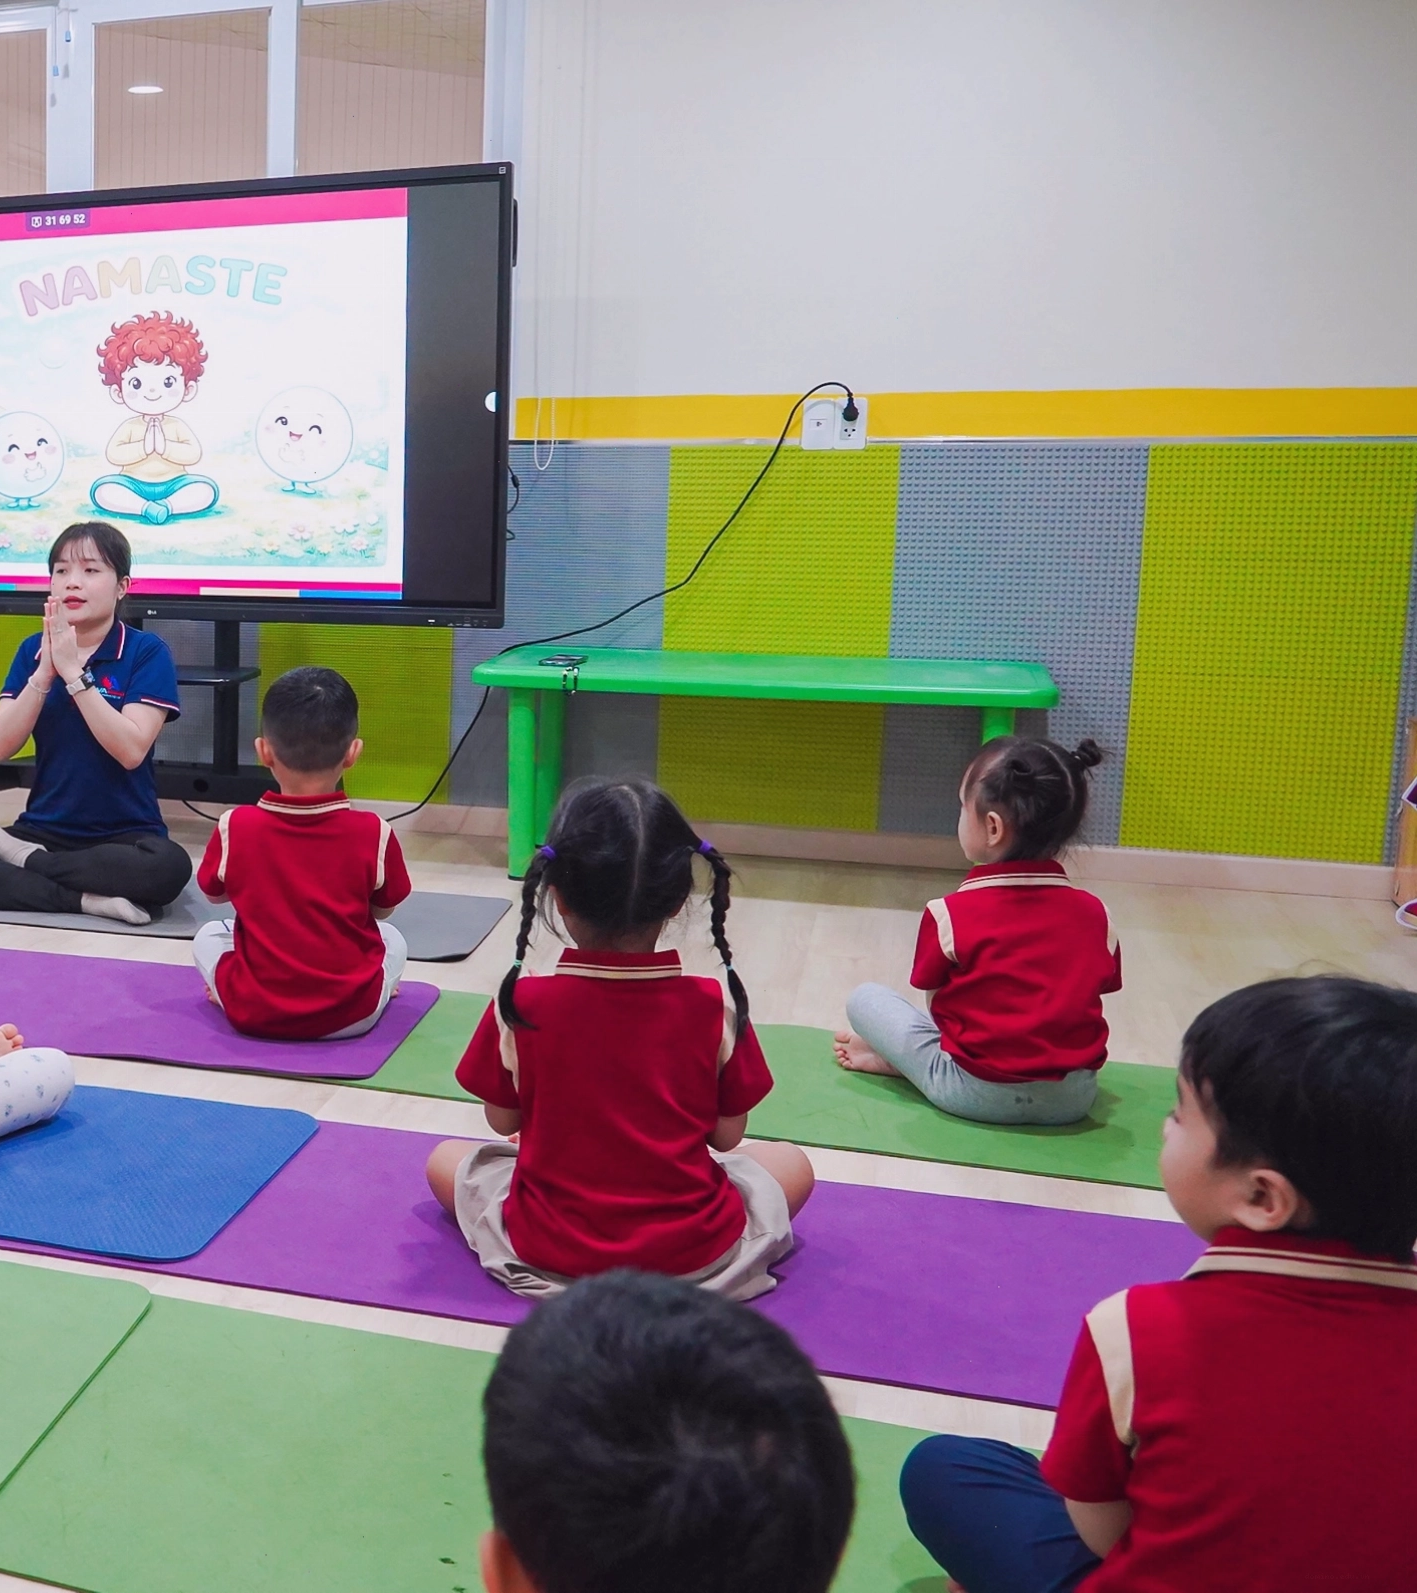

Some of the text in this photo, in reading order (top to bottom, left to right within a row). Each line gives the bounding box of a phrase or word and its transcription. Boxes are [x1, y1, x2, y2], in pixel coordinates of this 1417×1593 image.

[45, 213, 86, 226] 31 69 52
[19, 255, 288, 317] NAMASTE
